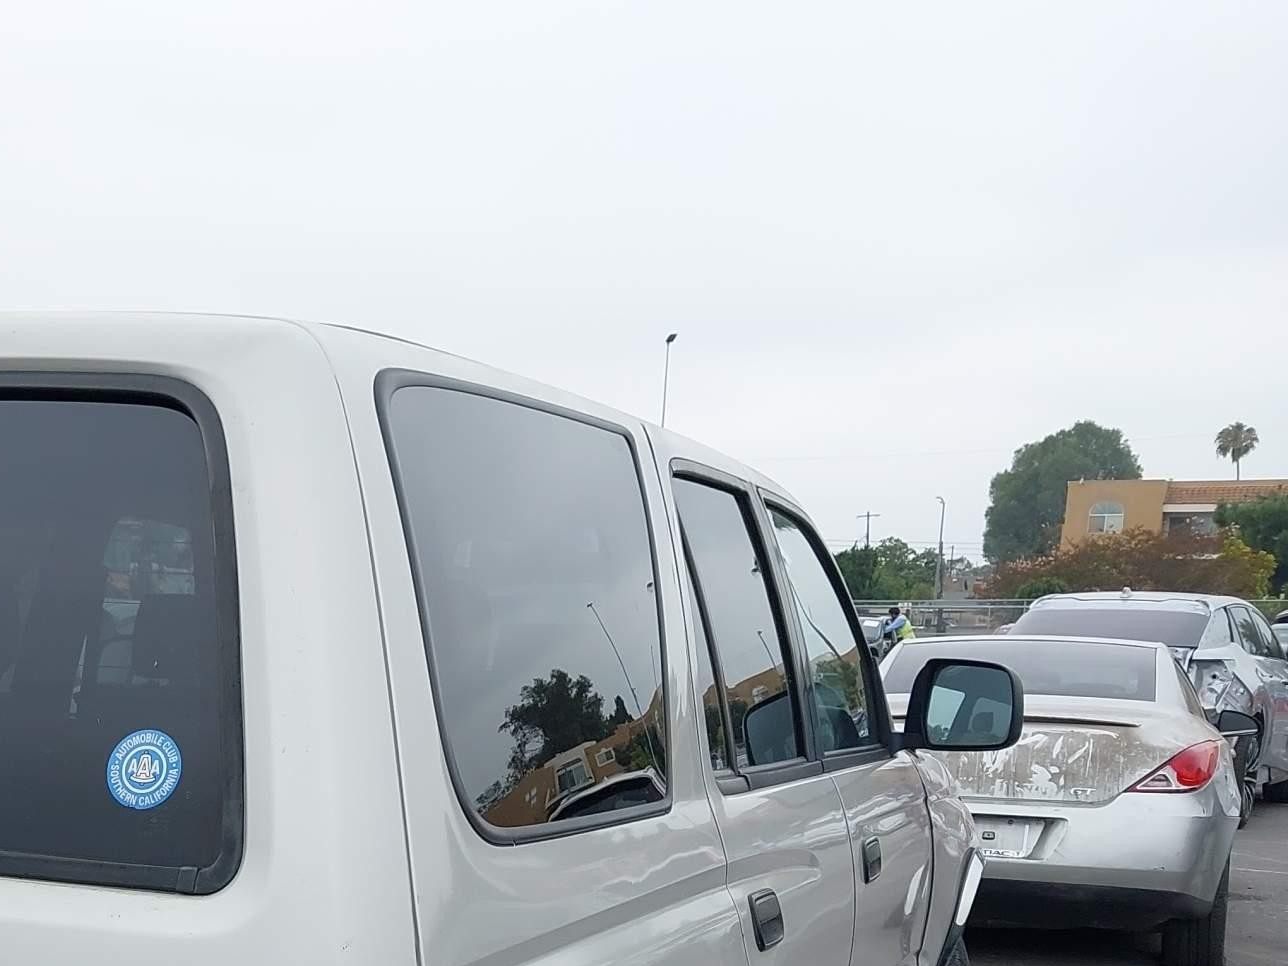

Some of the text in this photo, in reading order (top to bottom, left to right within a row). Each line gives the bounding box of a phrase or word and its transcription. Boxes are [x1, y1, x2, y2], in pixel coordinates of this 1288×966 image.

[115, 732, 178, 763] AUTOMOBILE CLUB
[127, 756, 160, 778] AAA
[111, 764, 179, 806] SOUTHERN CALIFORNIA
[1070, 787, 1097, 799] GT
